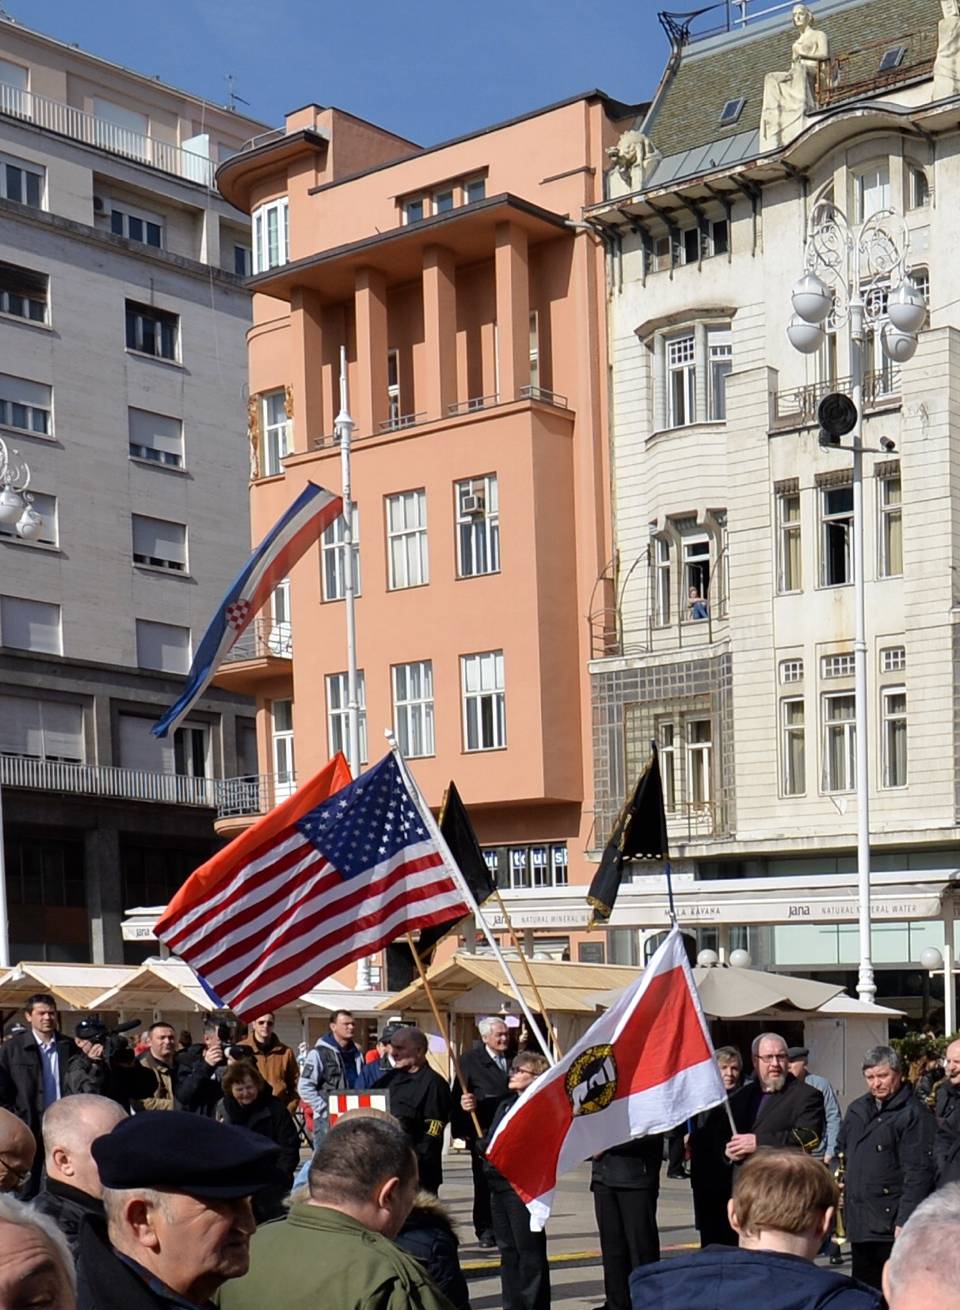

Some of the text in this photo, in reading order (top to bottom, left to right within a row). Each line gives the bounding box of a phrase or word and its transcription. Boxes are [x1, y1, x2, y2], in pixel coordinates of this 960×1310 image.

[788, 905, 811, 919] jana
[821, 905, 854, 915] NATURAL
[891, 903, 917, 913] WATER
